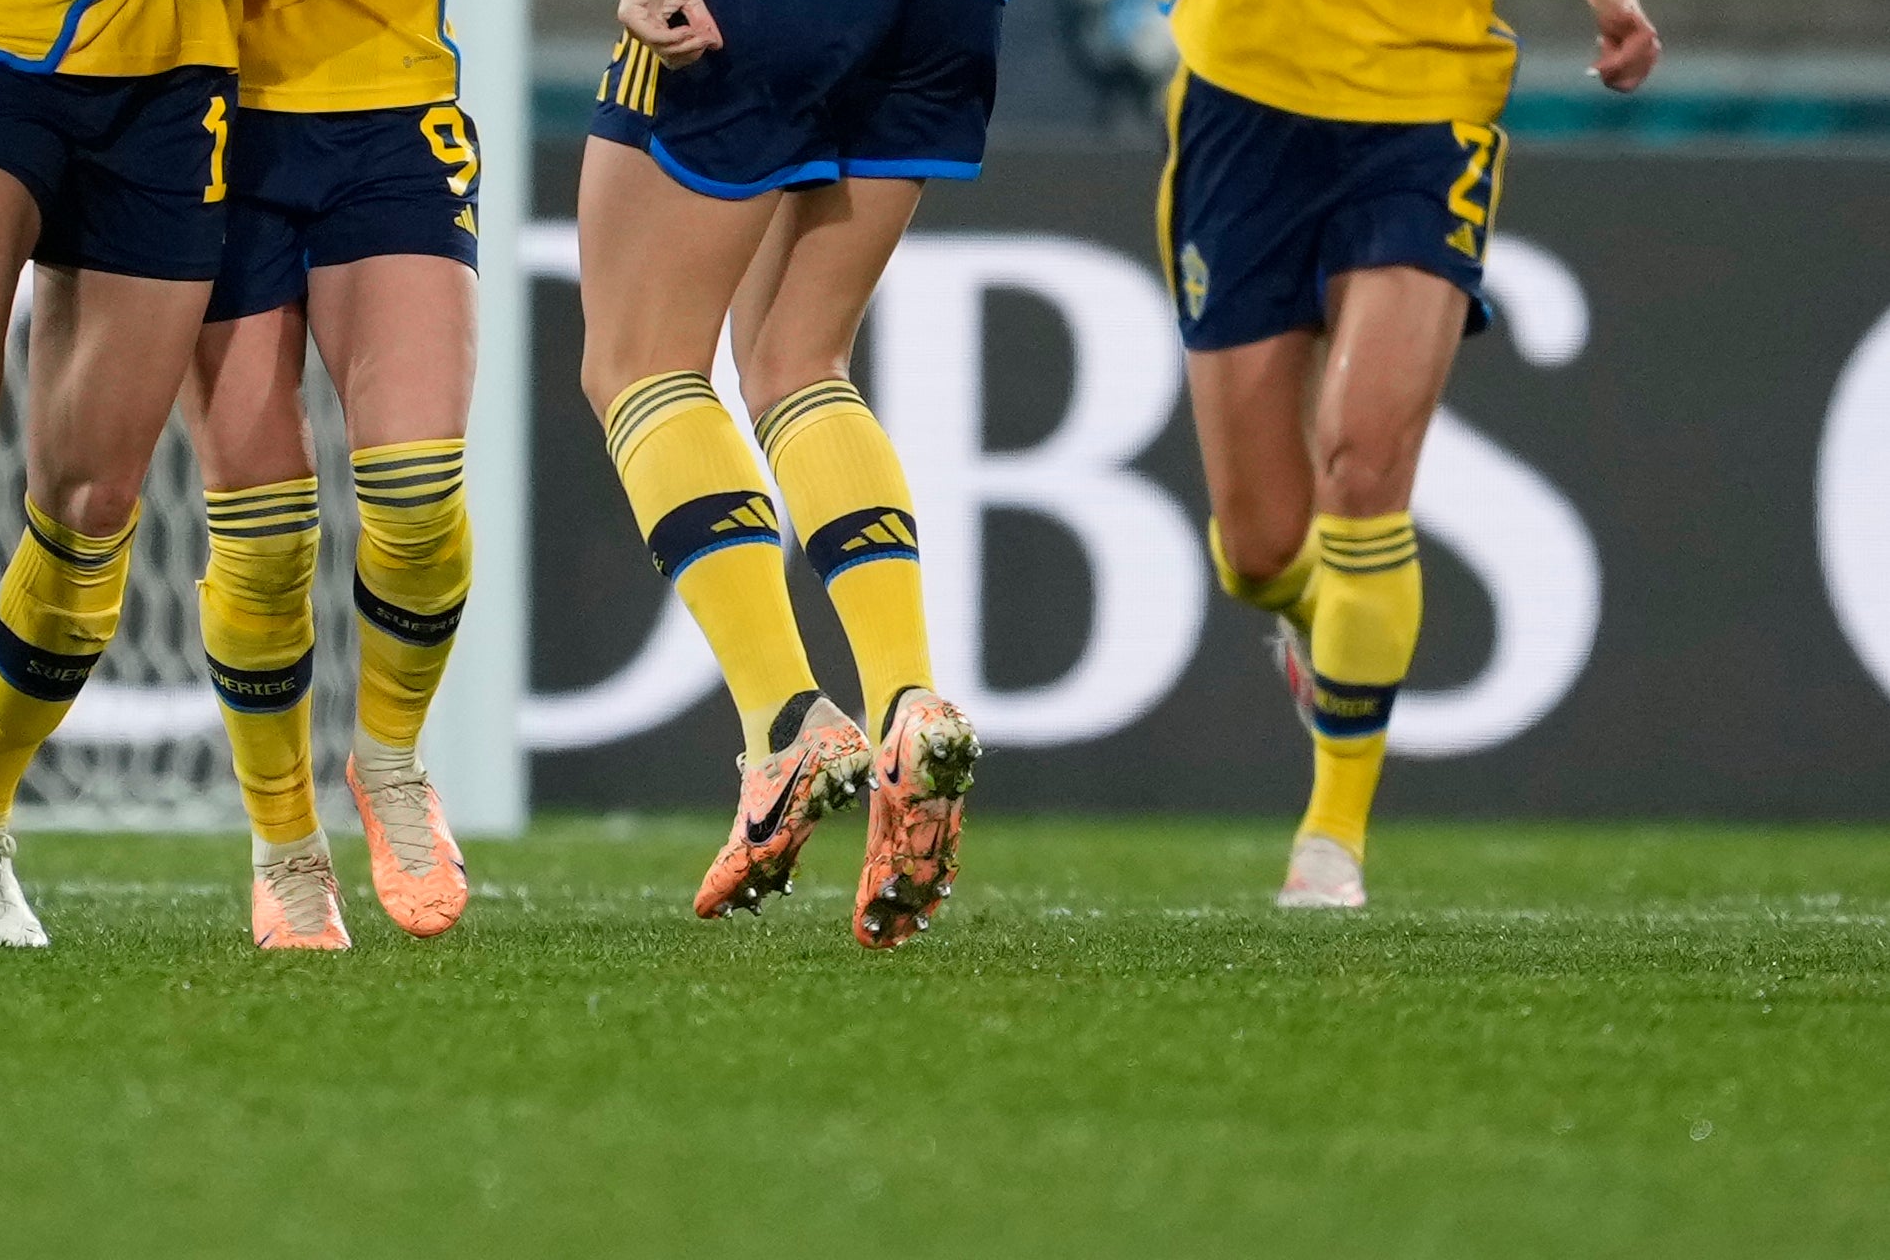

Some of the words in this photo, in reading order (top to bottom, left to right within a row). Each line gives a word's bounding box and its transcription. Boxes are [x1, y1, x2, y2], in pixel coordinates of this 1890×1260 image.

[202, 95, 228, 204] 1
[419, 106, 478, 197] 9
[1448, 121, 1494, 226] 2
